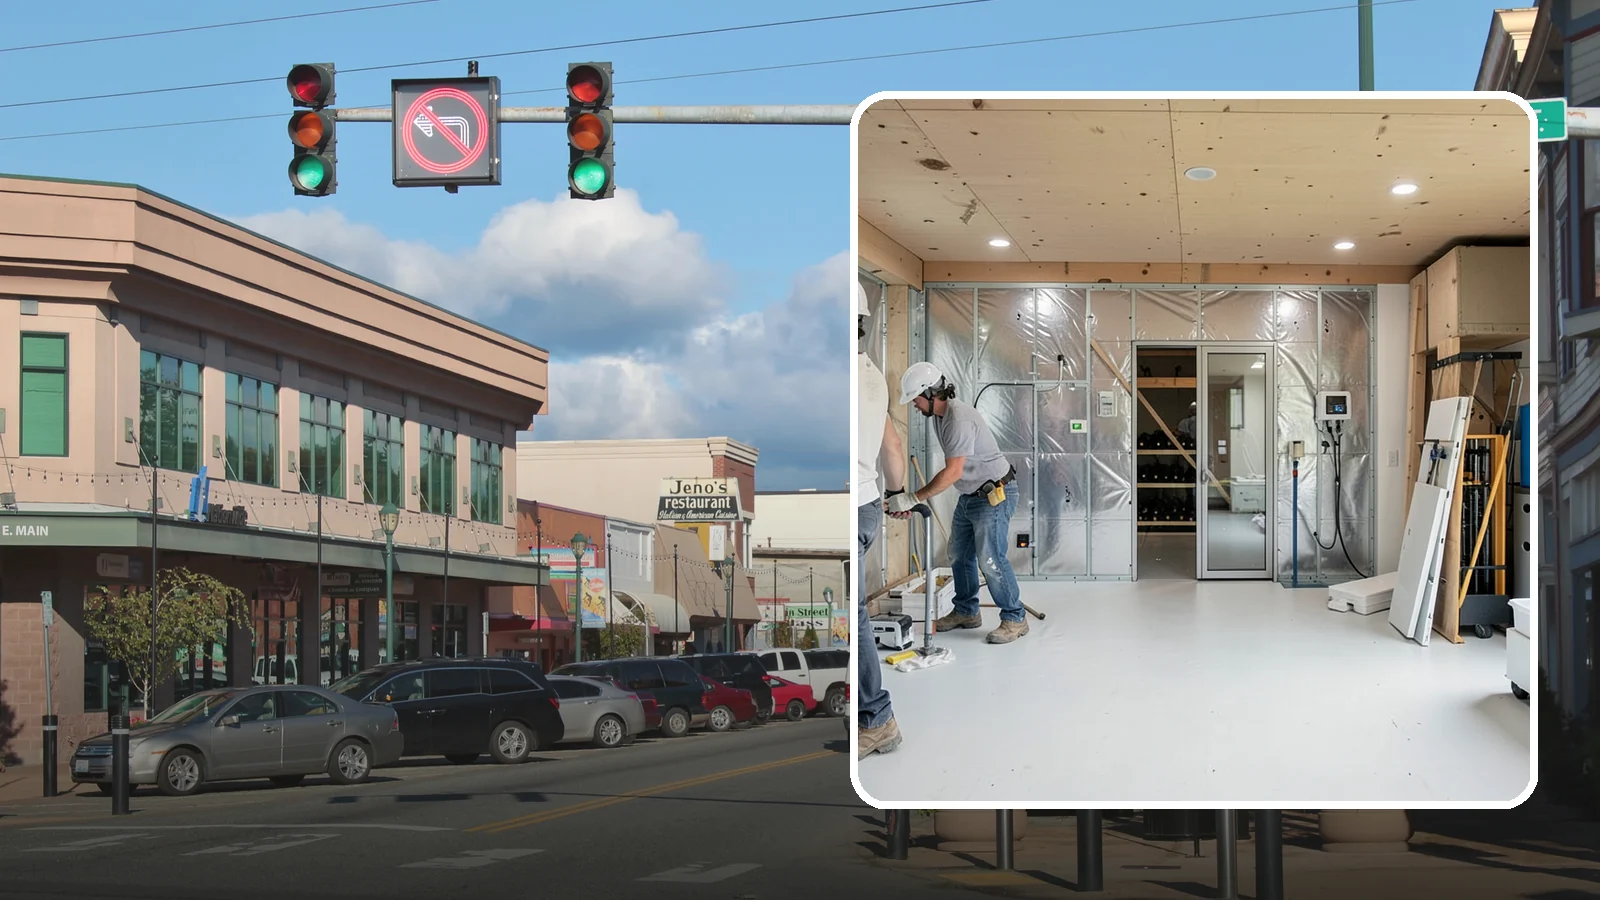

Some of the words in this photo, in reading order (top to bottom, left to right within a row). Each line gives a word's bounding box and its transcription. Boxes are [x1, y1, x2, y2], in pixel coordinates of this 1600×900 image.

[669, 480, 728, 495] Jeno's
[665, 496, 731, 509] restaurant
[658, 510, 681, 520] Italian
[686, 510, 715, 519] American
[715, 509, 738, 519] Cuisine
[2, 525, 13, 536] E.
[15, 525, 49, 536] MAIN
[797, 607, 829, 617] Street
